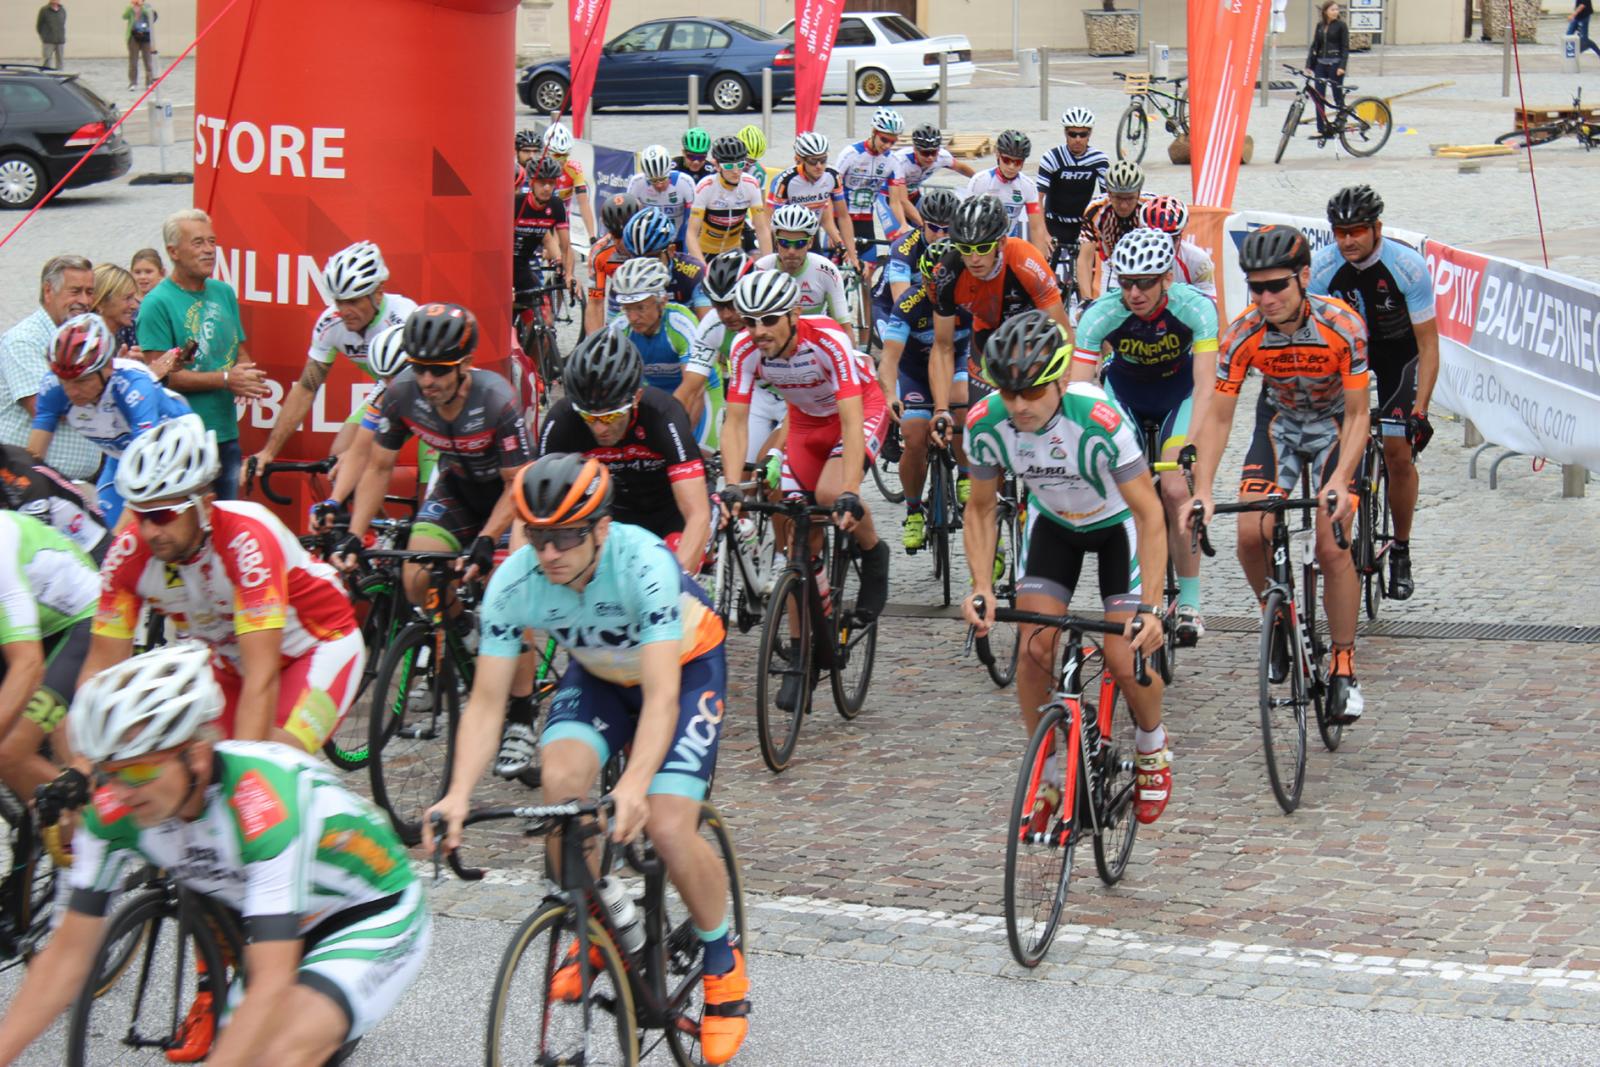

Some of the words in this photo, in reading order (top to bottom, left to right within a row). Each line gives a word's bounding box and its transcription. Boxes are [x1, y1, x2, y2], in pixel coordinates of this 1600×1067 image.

[195, 113, 346, 179] STORE
[213, 245, 335, 306] NLIN
[1118, 333, 1181, 357] DYNAMO
